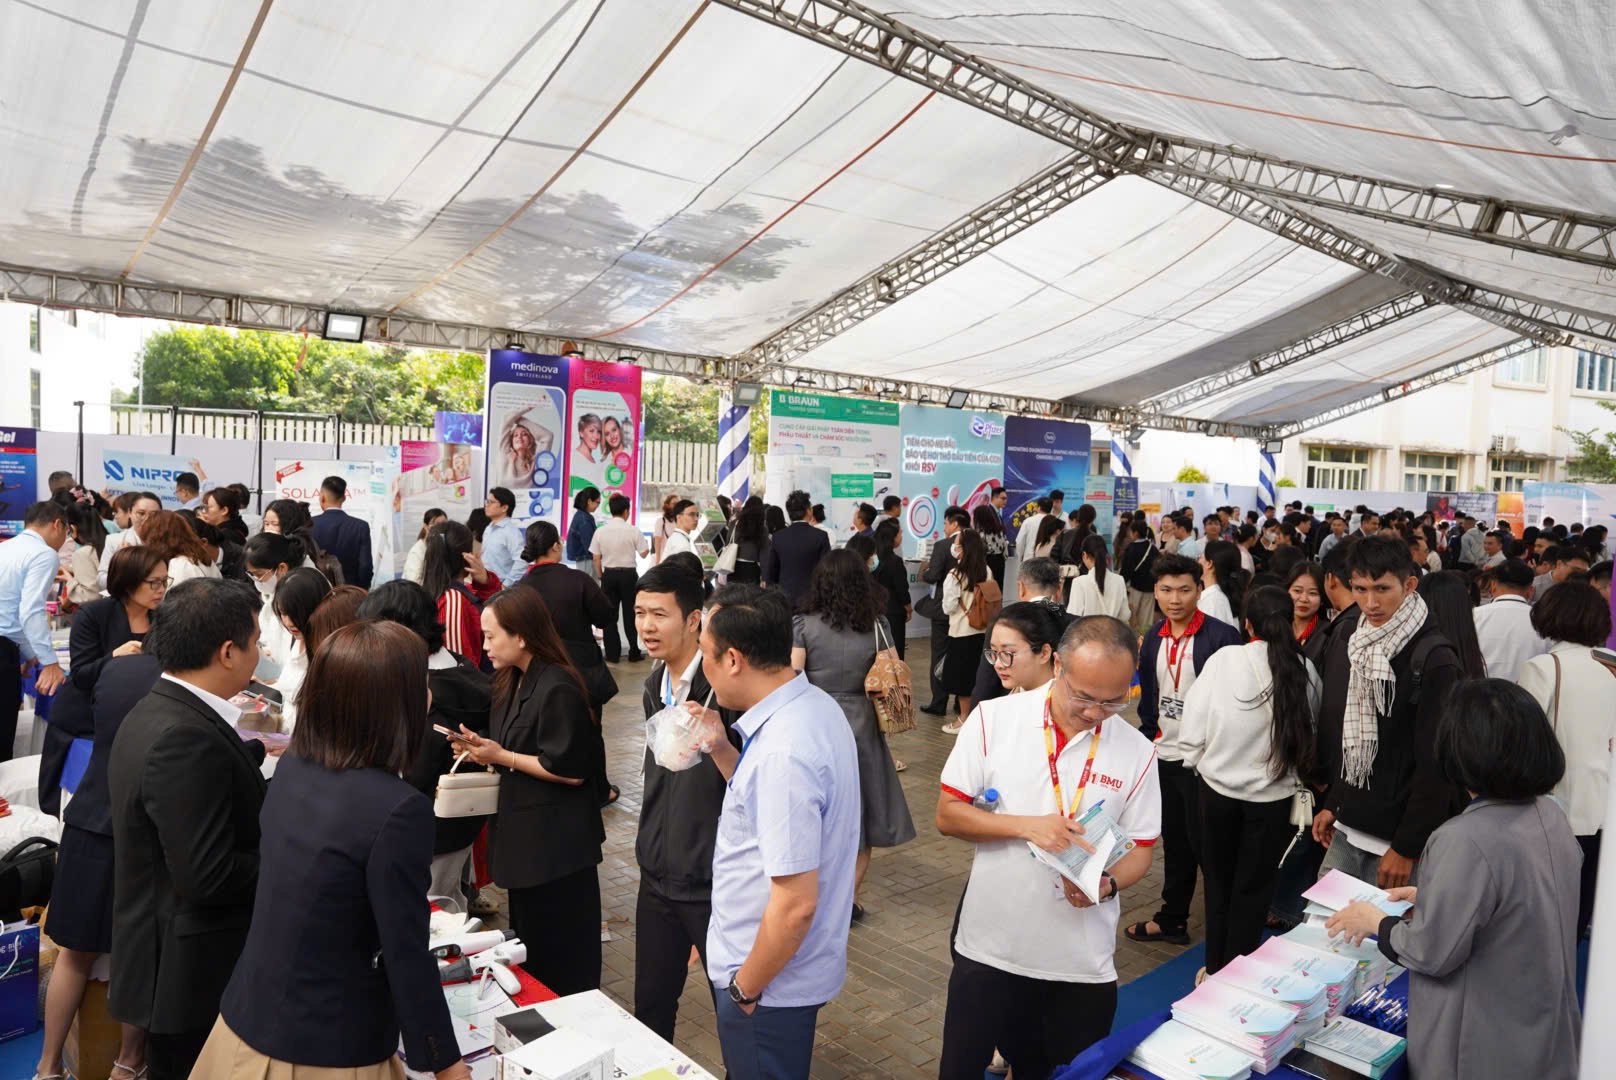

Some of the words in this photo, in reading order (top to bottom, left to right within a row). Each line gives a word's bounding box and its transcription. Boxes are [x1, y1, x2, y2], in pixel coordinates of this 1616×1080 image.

[511, 362, 558, 374] medinova
[788, 395, 819, 406] BRAUN
[984, 422, 1004, 439] Pfizer
[921, 462, 937, 472] RSV
[1100, 774, 1123, 789] BMU
